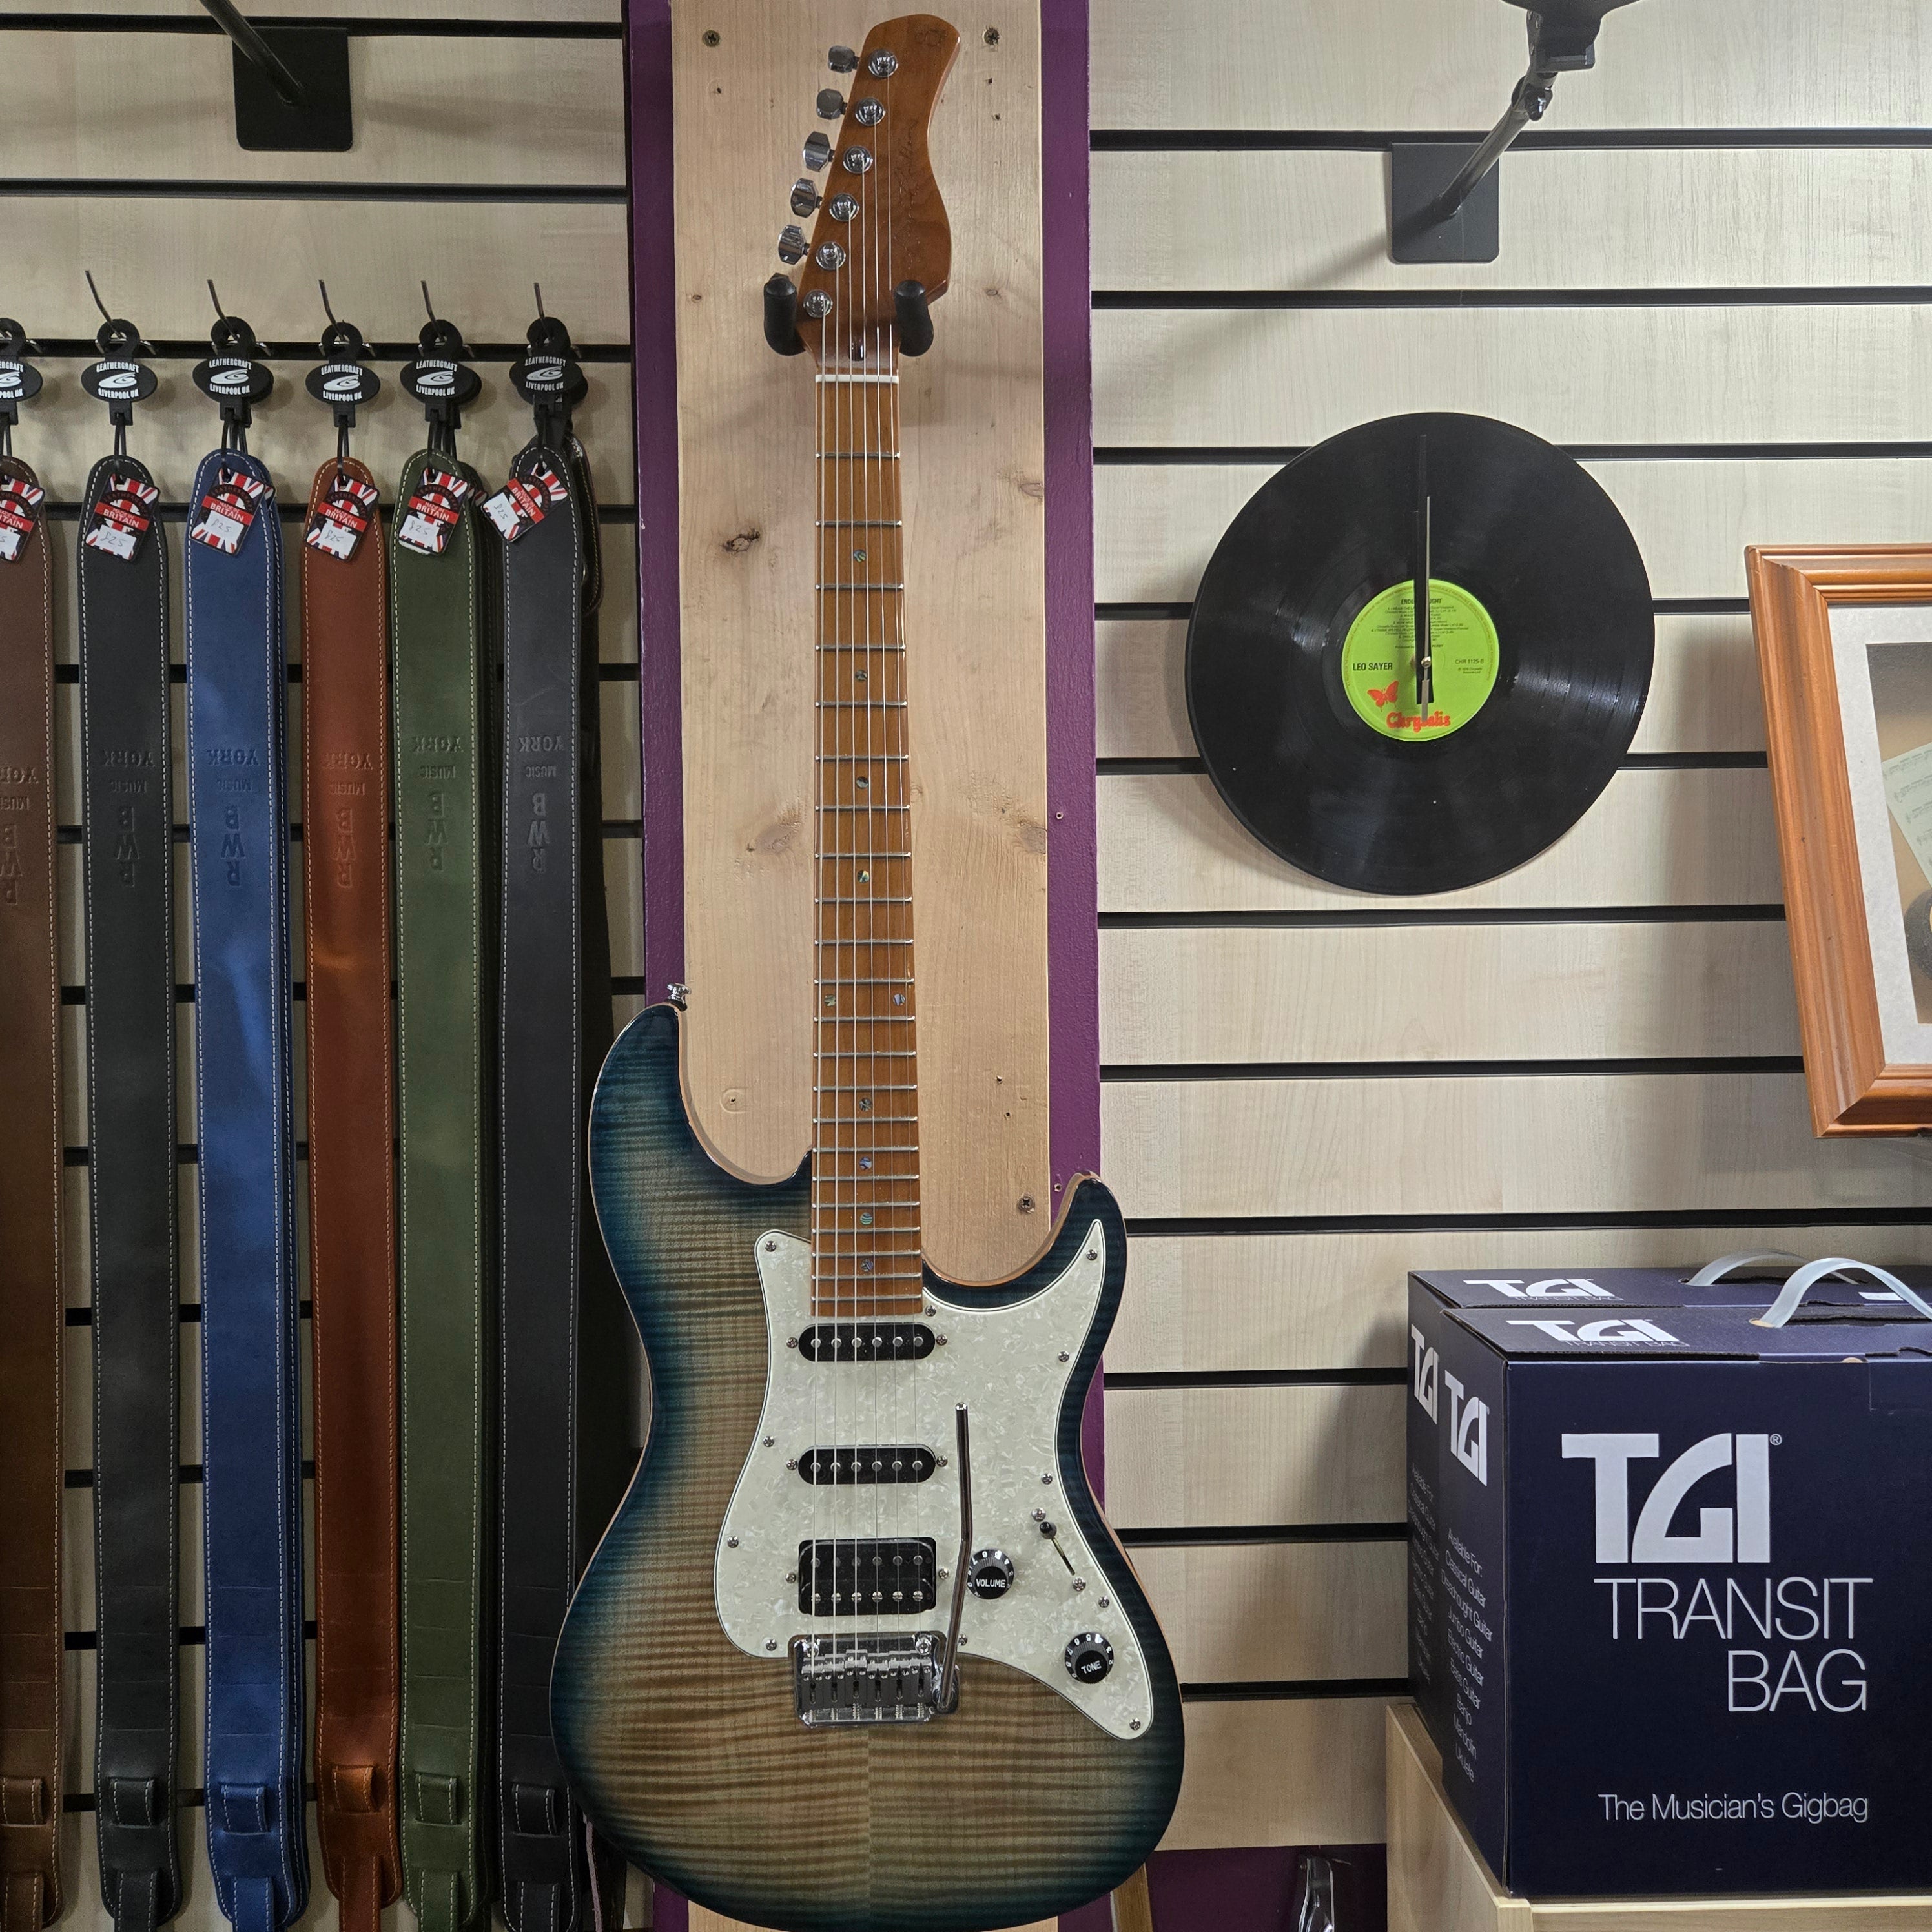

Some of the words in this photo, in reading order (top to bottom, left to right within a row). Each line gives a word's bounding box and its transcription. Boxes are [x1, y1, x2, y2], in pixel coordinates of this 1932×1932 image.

[0, 361, 23, 373] ERGRAFT
[98, 389, 129, 399] LIVERPOOL
[130, 389, 139, 398] UK
[209, 384, 241, 395] LIVERPOOL
[242, 385, 250, 394] UK
[416, 384, 446, 396] LIVERPOOL
[447, 386, 455, 395] UK
[526, 381, 555, 391] LIVERPOOL
[323, 391, 353, 402] LIVERPOOL
[354, 391, 362, 400] UK
[511, 487, 536, 516] BRITAIN
[103, 508, 139, 528] BRITAIN
[210, 503, 244, 522] BRITAIN
[325, 509, 358, 528] BRITAIN
[416, 503, 450, 521] BRITAIN
[1368, 663, 1393, 671] SAYER
[412, 735, 464, 754] YORK
[517, 735, 565, 752] YORK
[103, 749, 156, 768] YORK
[206, 748, 260, 766] YORK
[322, 752, 373, 771] YORK
[0, 766, 39, 784] YOR
[418, 765, 457, 779] MUSIC
[525, 765, 557, 778] MUSIC
[110, 777, 148, 794] MUSIC
[216, 777, 253, 793] MUSIC
[330, 780, 366, 796] MUSIC
[0, 796, 30, 810] MUS
[1448, 1528, 1470, 1565] Available
[976, 1579, 1006, 1588] VOLUME
[1445, 1550, 1467, 1586] Classical
[1468, 1577, 1486, 1608] Guitar
[1594, 1577, 1873, 1640] TRANSIT
[1473, 1610, 1493, 1642] Guitar
[1465, 1628, 1484, 1659] Guitar
[1448, 1628, 1465, 1664] Electric
[1465, 1654, 1484, 1686] Guitar
[1081, 1660, 1102, 1674] TONE
[1727, 1649, 1867, 1712] BAG
[1463, 1678, 1481, 1709] Guitar
[1457, 1693, 1472, 1726] Banjo
[1598, 1794, 1645, 1821] The
[1652, 1793, 1774, 1820] Musician's
[1782, 1792, 1868, 1824] Gigbag
